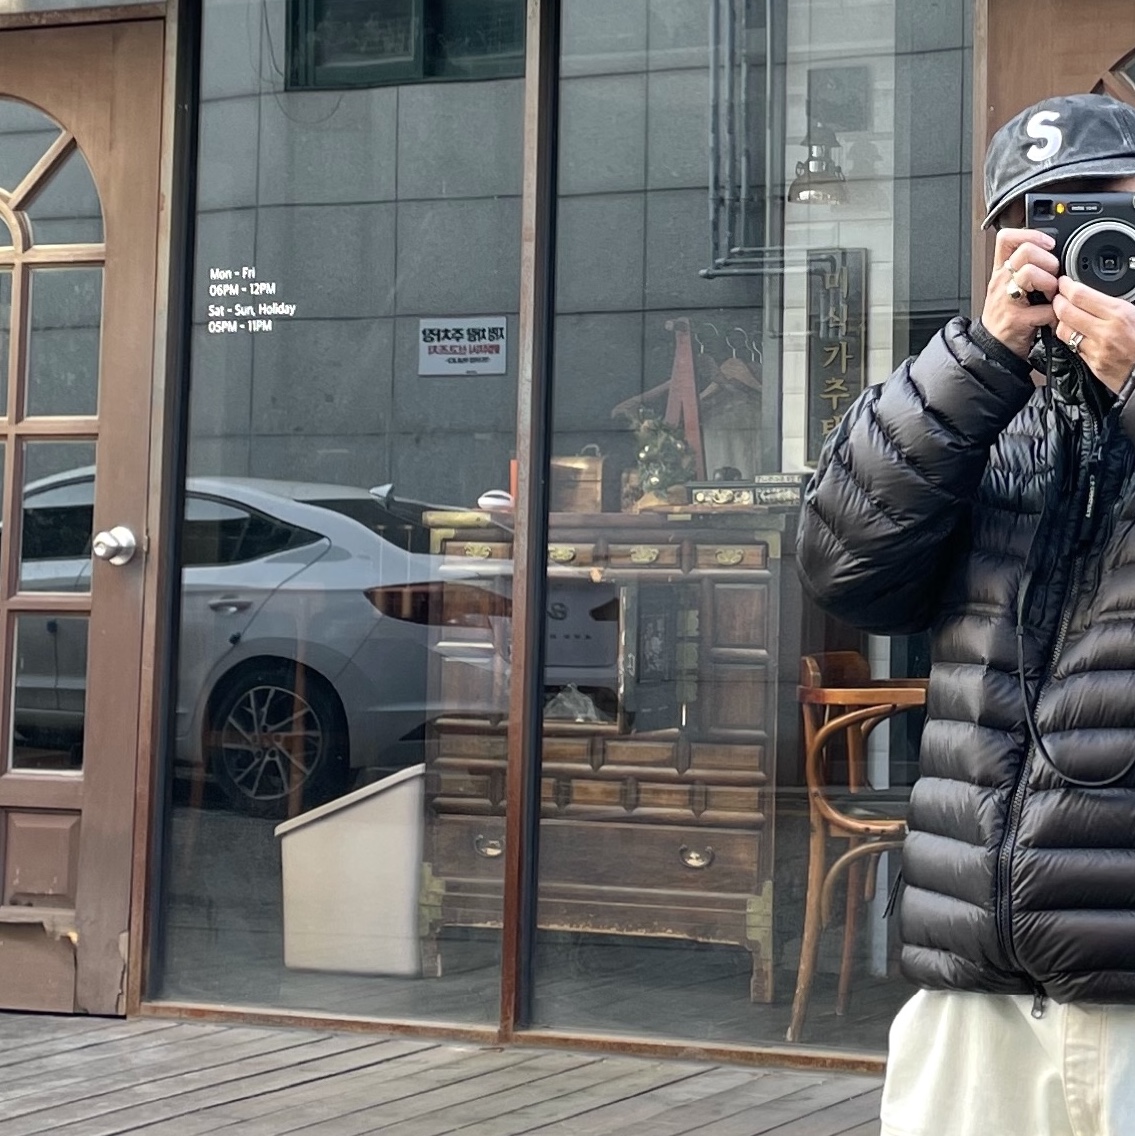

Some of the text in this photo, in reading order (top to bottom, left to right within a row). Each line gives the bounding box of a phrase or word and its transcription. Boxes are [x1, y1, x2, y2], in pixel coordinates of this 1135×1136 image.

[1026, 110, 1063, 162] S
[210, 268, 232, 280] Mon
[242, 266, 256, 279] Fri
[209, 283, 240, 297] 06PM
[249, 282, 277, 296] 12PM
[208, 304, 225, 317] Sat
[234, 303, 257, 317] Sun,
[258, 302, 297, 317] Holiday
[208, 320, 238, 333] 05PM
[247, 319, 273, 332] 11PM
